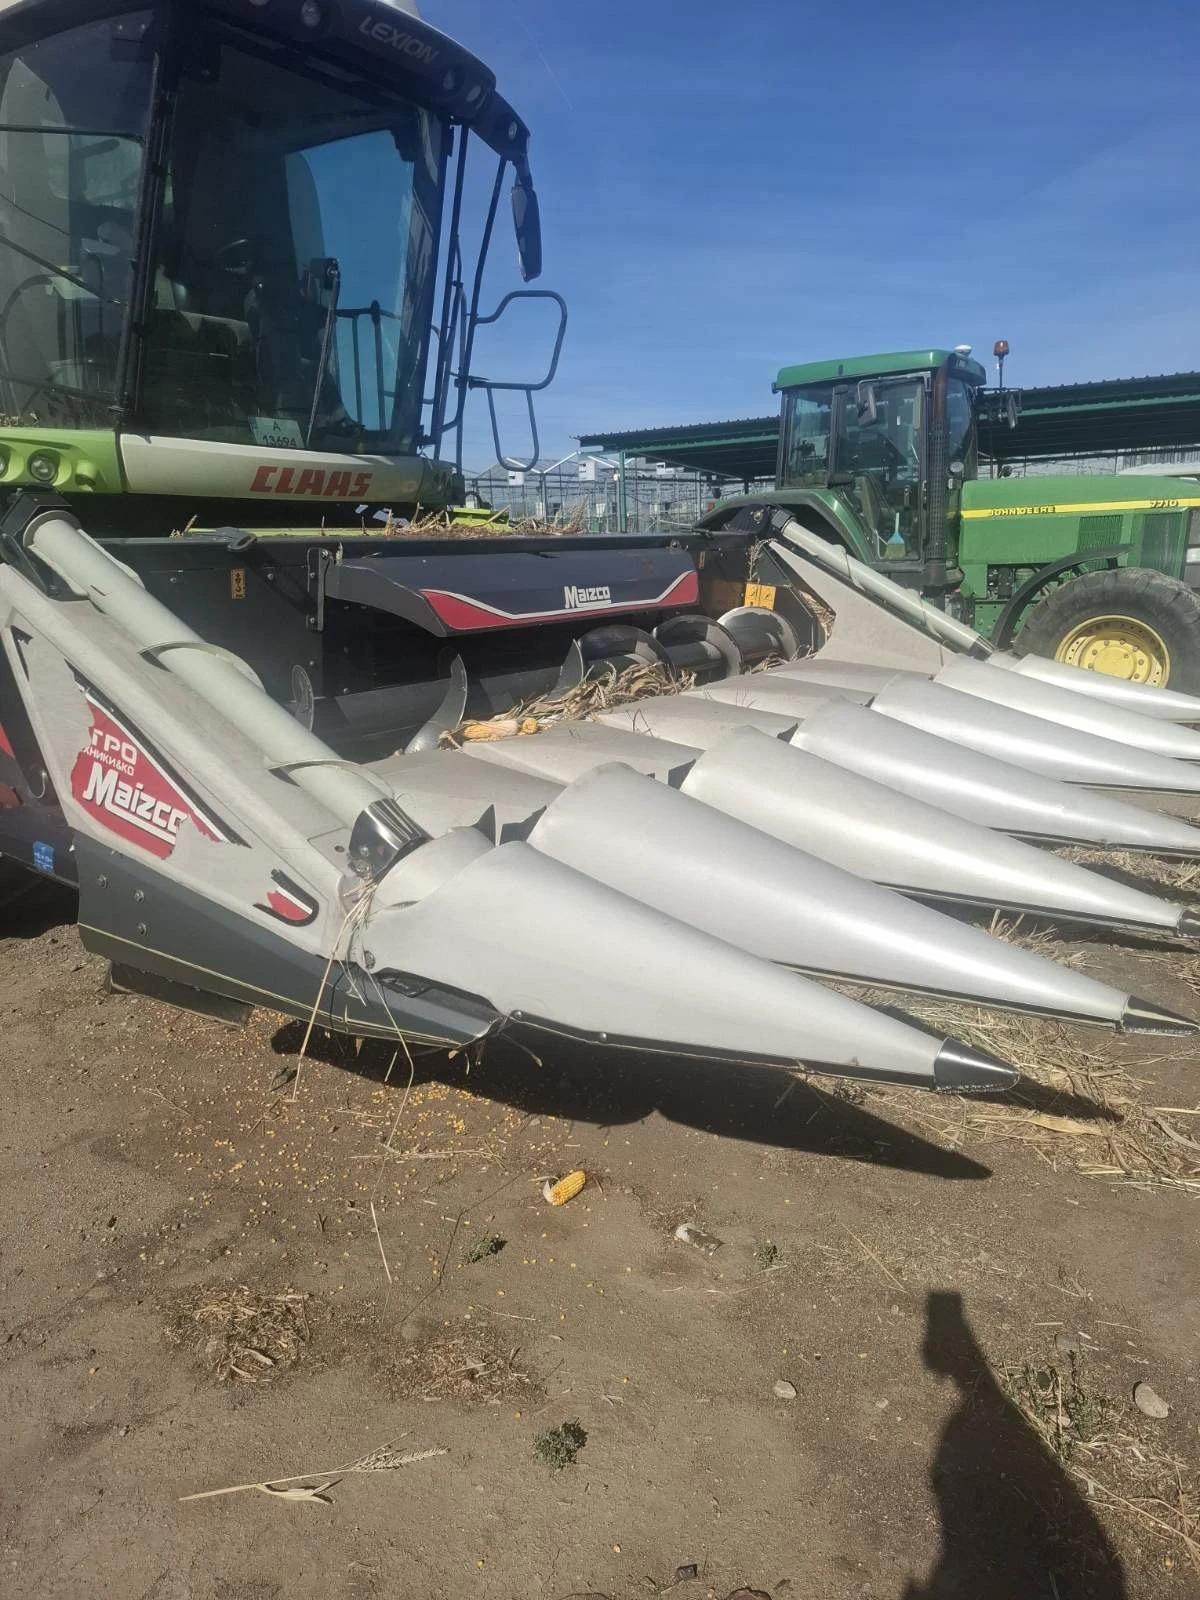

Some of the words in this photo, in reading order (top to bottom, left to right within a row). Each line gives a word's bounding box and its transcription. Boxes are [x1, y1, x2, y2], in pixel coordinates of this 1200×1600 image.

[359, 16, 438, 63] LEXION
[250, 466, 373, 497] CLAAS
[992, 507, 1016, 516] JOHN
[1017, 505, 1055, 515] DEERE
[564, 585, 611, 608] Maizco
